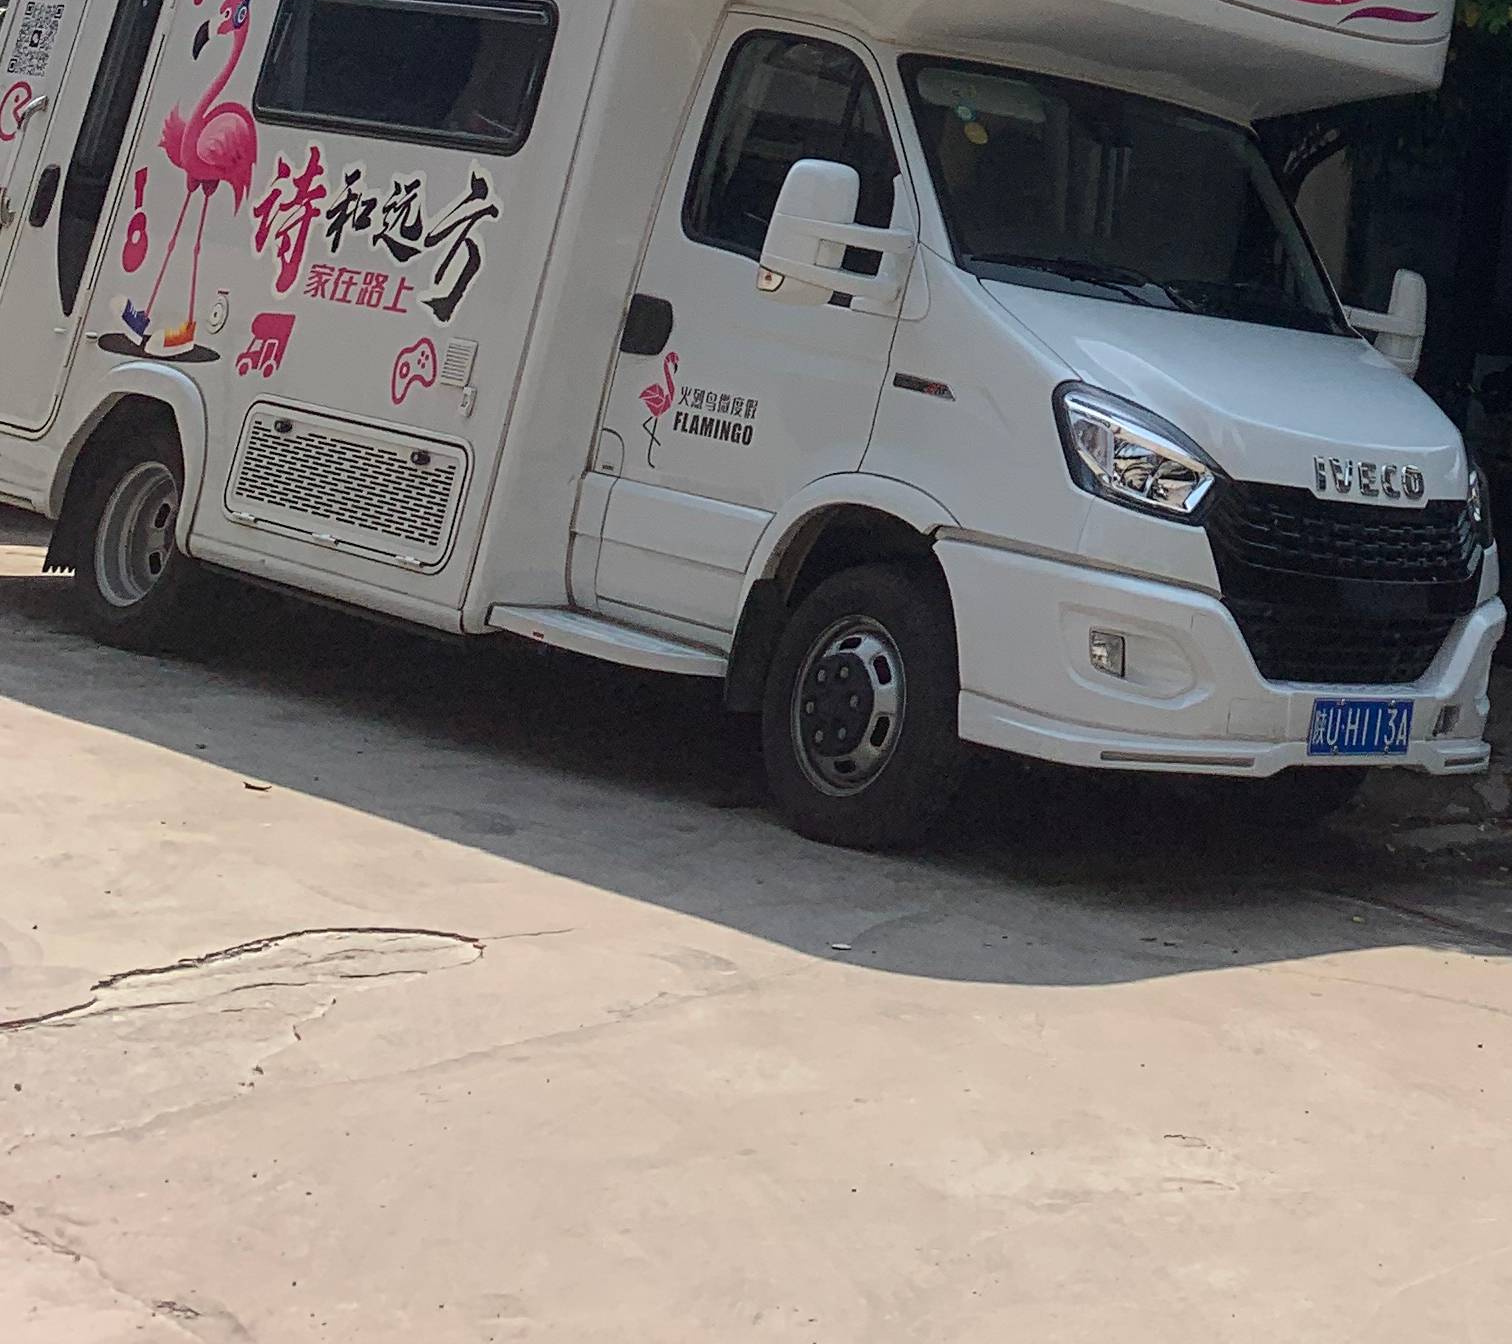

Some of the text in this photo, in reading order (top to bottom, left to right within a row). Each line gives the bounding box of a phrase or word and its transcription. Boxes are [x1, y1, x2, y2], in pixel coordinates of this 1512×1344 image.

[253, 146, 499, 322] 诗和远方
[303, 264, 415, 314] 家在路上
[678, 386, 759, 419] 火烈鸟微度假
[673, 410, 754, 446] FLAMINGO
[1313, 455, 1426, 500] IVECO
